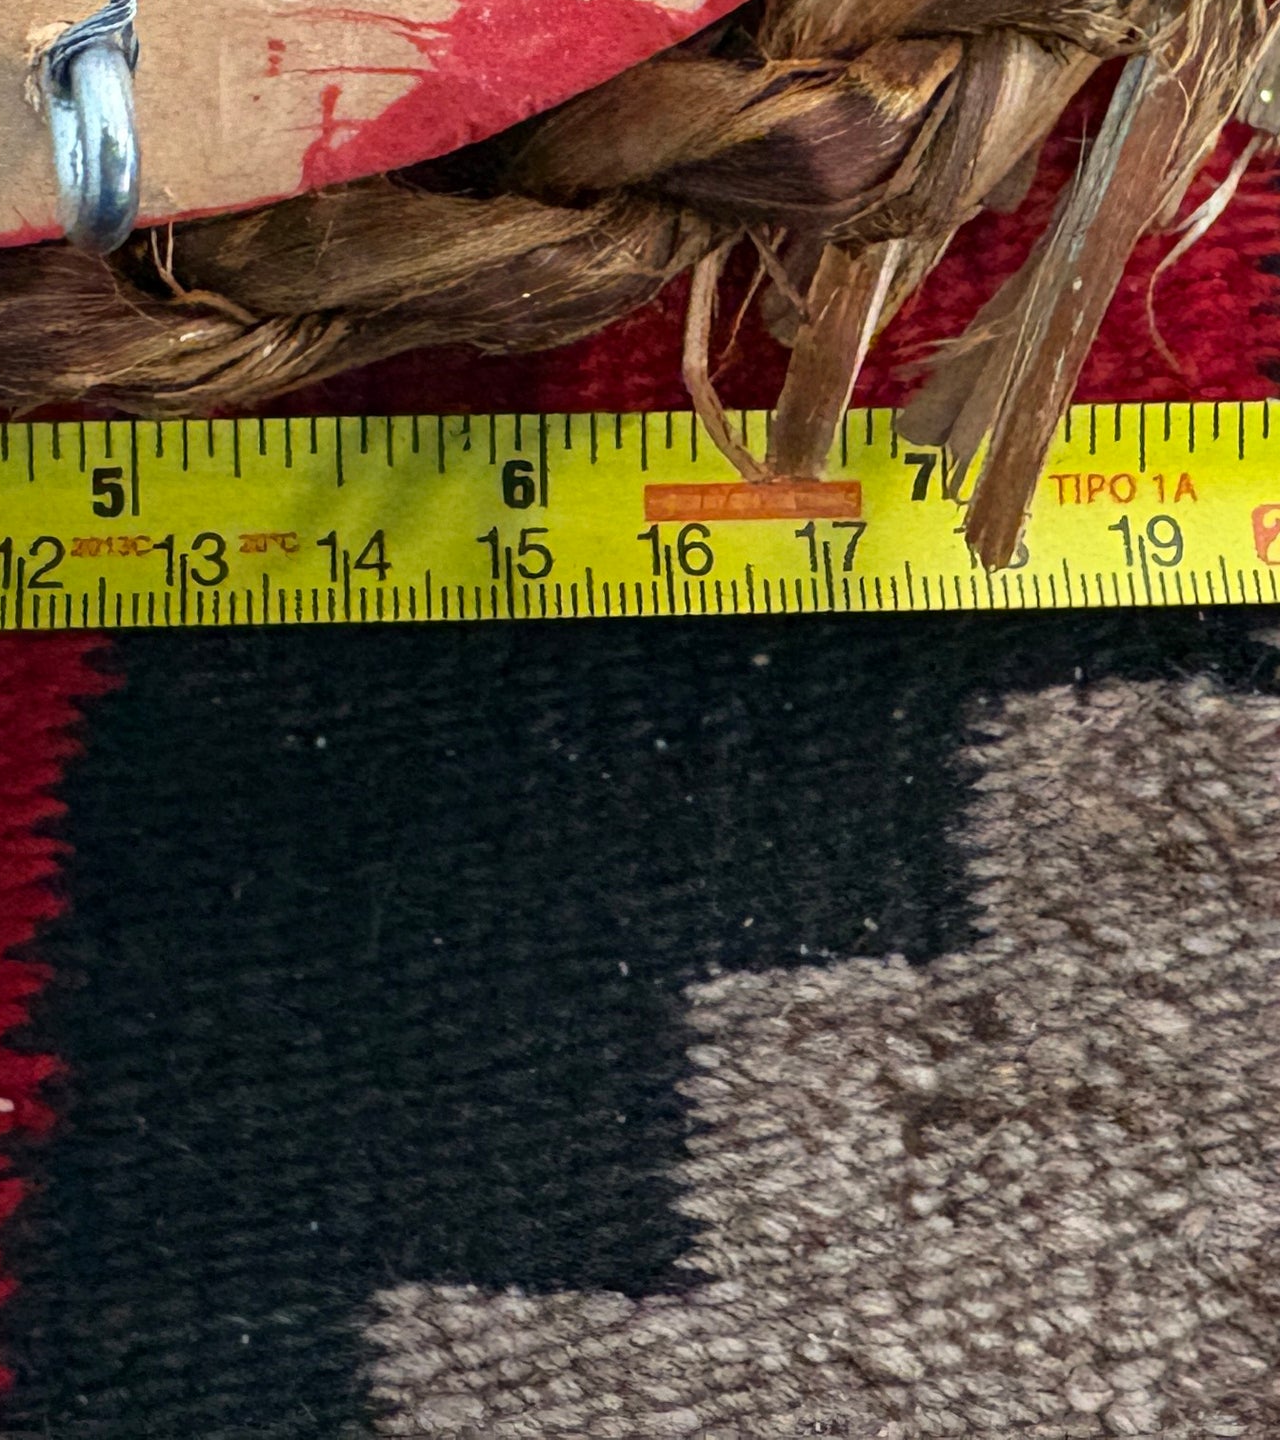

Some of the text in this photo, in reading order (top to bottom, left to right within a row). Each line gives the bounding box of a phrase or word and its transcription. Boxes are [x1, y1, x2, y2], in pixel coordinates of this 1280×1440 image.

[92, 466, 125, 518] 5
[502, 460, 536, 509] 6
[904, 453, 937, 501] 7
[1048, 471, 1198, 505] TIPO 1A
[152, 532, 229, 586] 13
[317, 529, 392, 582] 14
[476, 526, 554, 579] 15
[637, 523, 714, 577] 16
[795, 521, 867, 573] 17
[1108, 514, 1184, 567] 19
